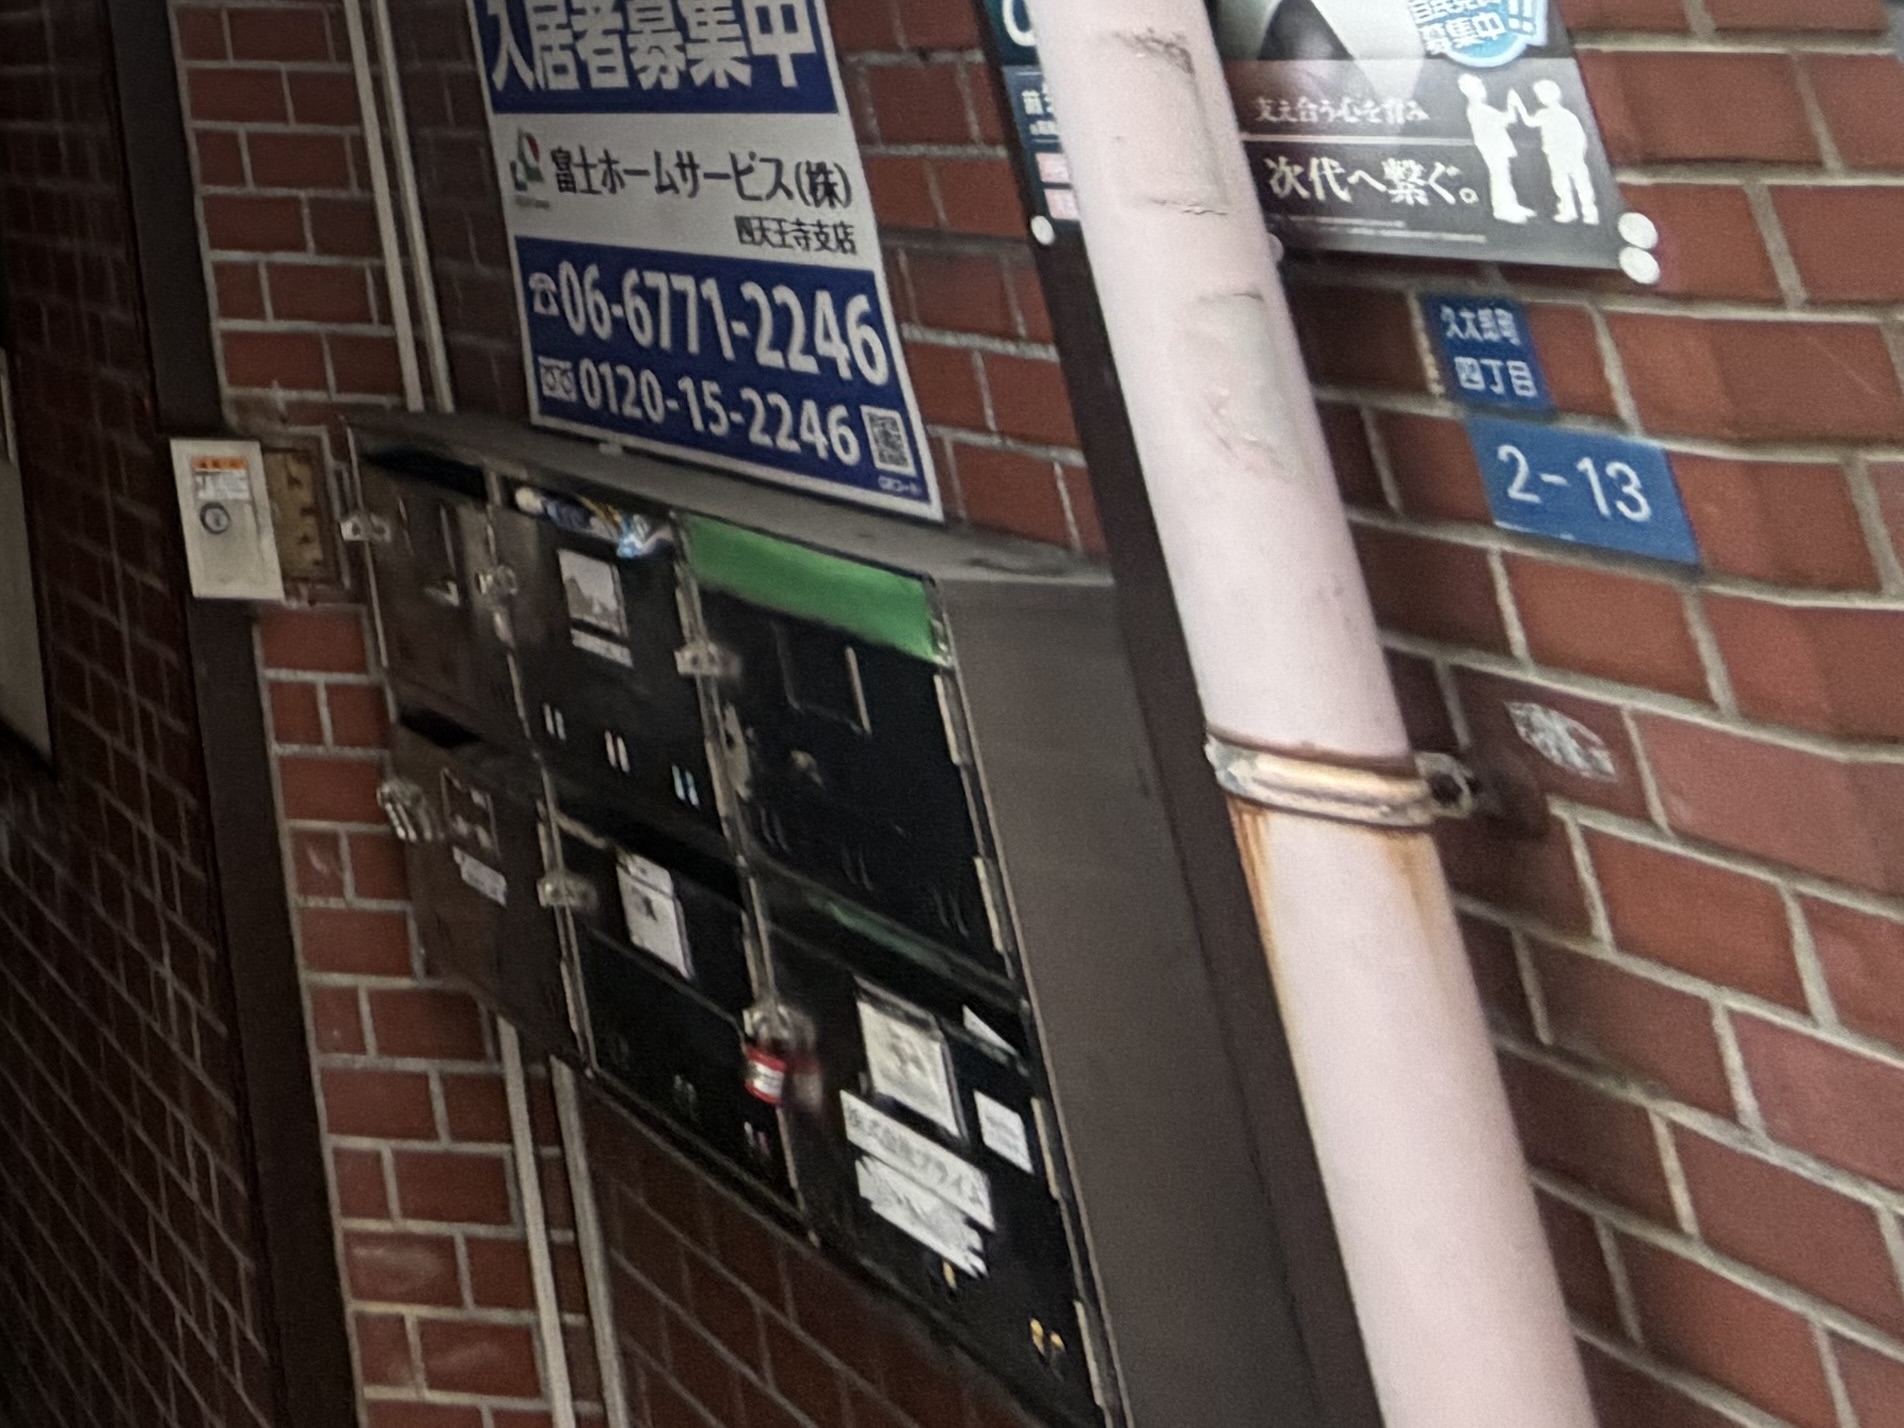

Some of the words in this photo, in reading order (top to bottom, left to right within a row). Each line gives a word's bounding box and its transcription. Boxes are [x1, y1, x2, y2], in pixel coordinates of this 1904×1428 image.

[549, 144, 852, 210] 富士ホームサービス(株)
[1264, 154, 1480, 206] 次代へ繋ぐ。
[557, 259, 891, 387] 06-6771-2246
[578, 355, 862, 468] 0120-15-2246
[1452, 355, 1538, 398] 四丁目
[1496, 443, 1653, 523] 2-13
